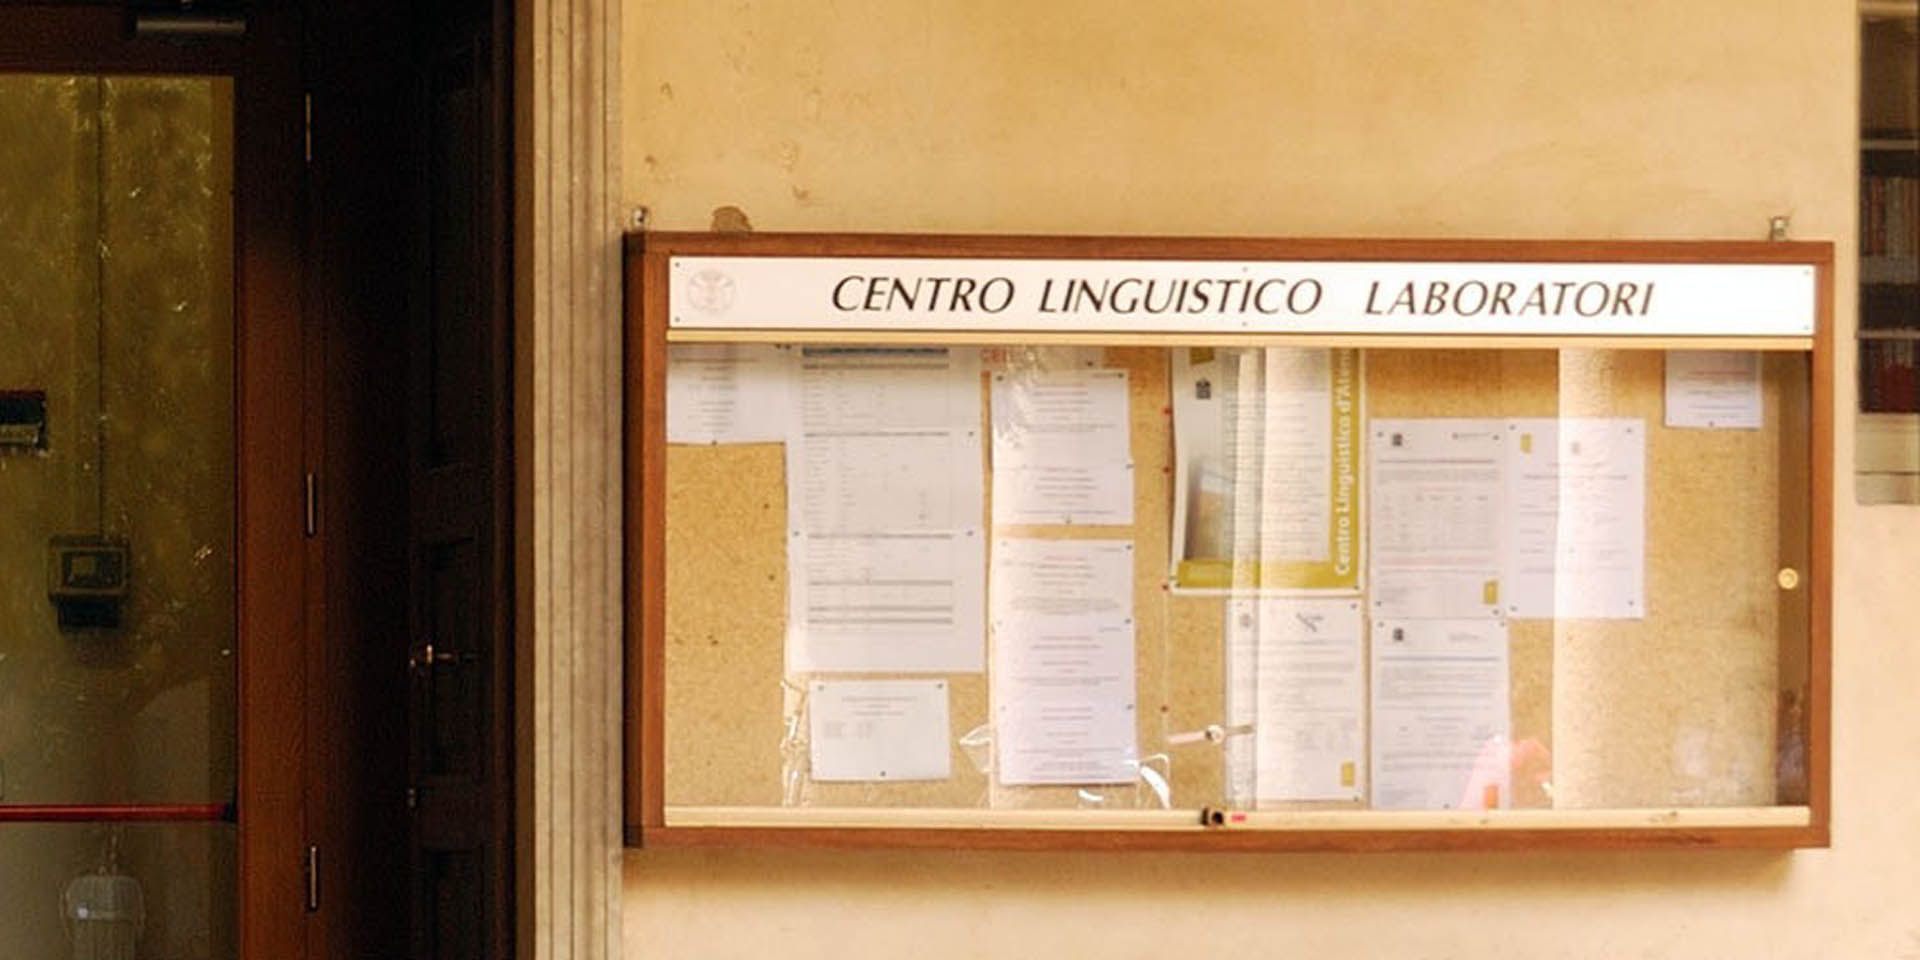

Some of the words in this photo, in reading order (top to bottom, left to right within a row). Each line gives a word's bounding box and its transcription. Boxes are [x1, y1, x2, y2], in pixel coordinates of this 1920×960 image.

[831, 274, 1015, 313] CENTRO
[1039, 278, 1323, 314] LINGUISTICO
[1365, 281, 1656, 317] LABORATORI
[1335, 416, 1354, 512] Linguistico
[1334, 515, 1351, 575] Centro
